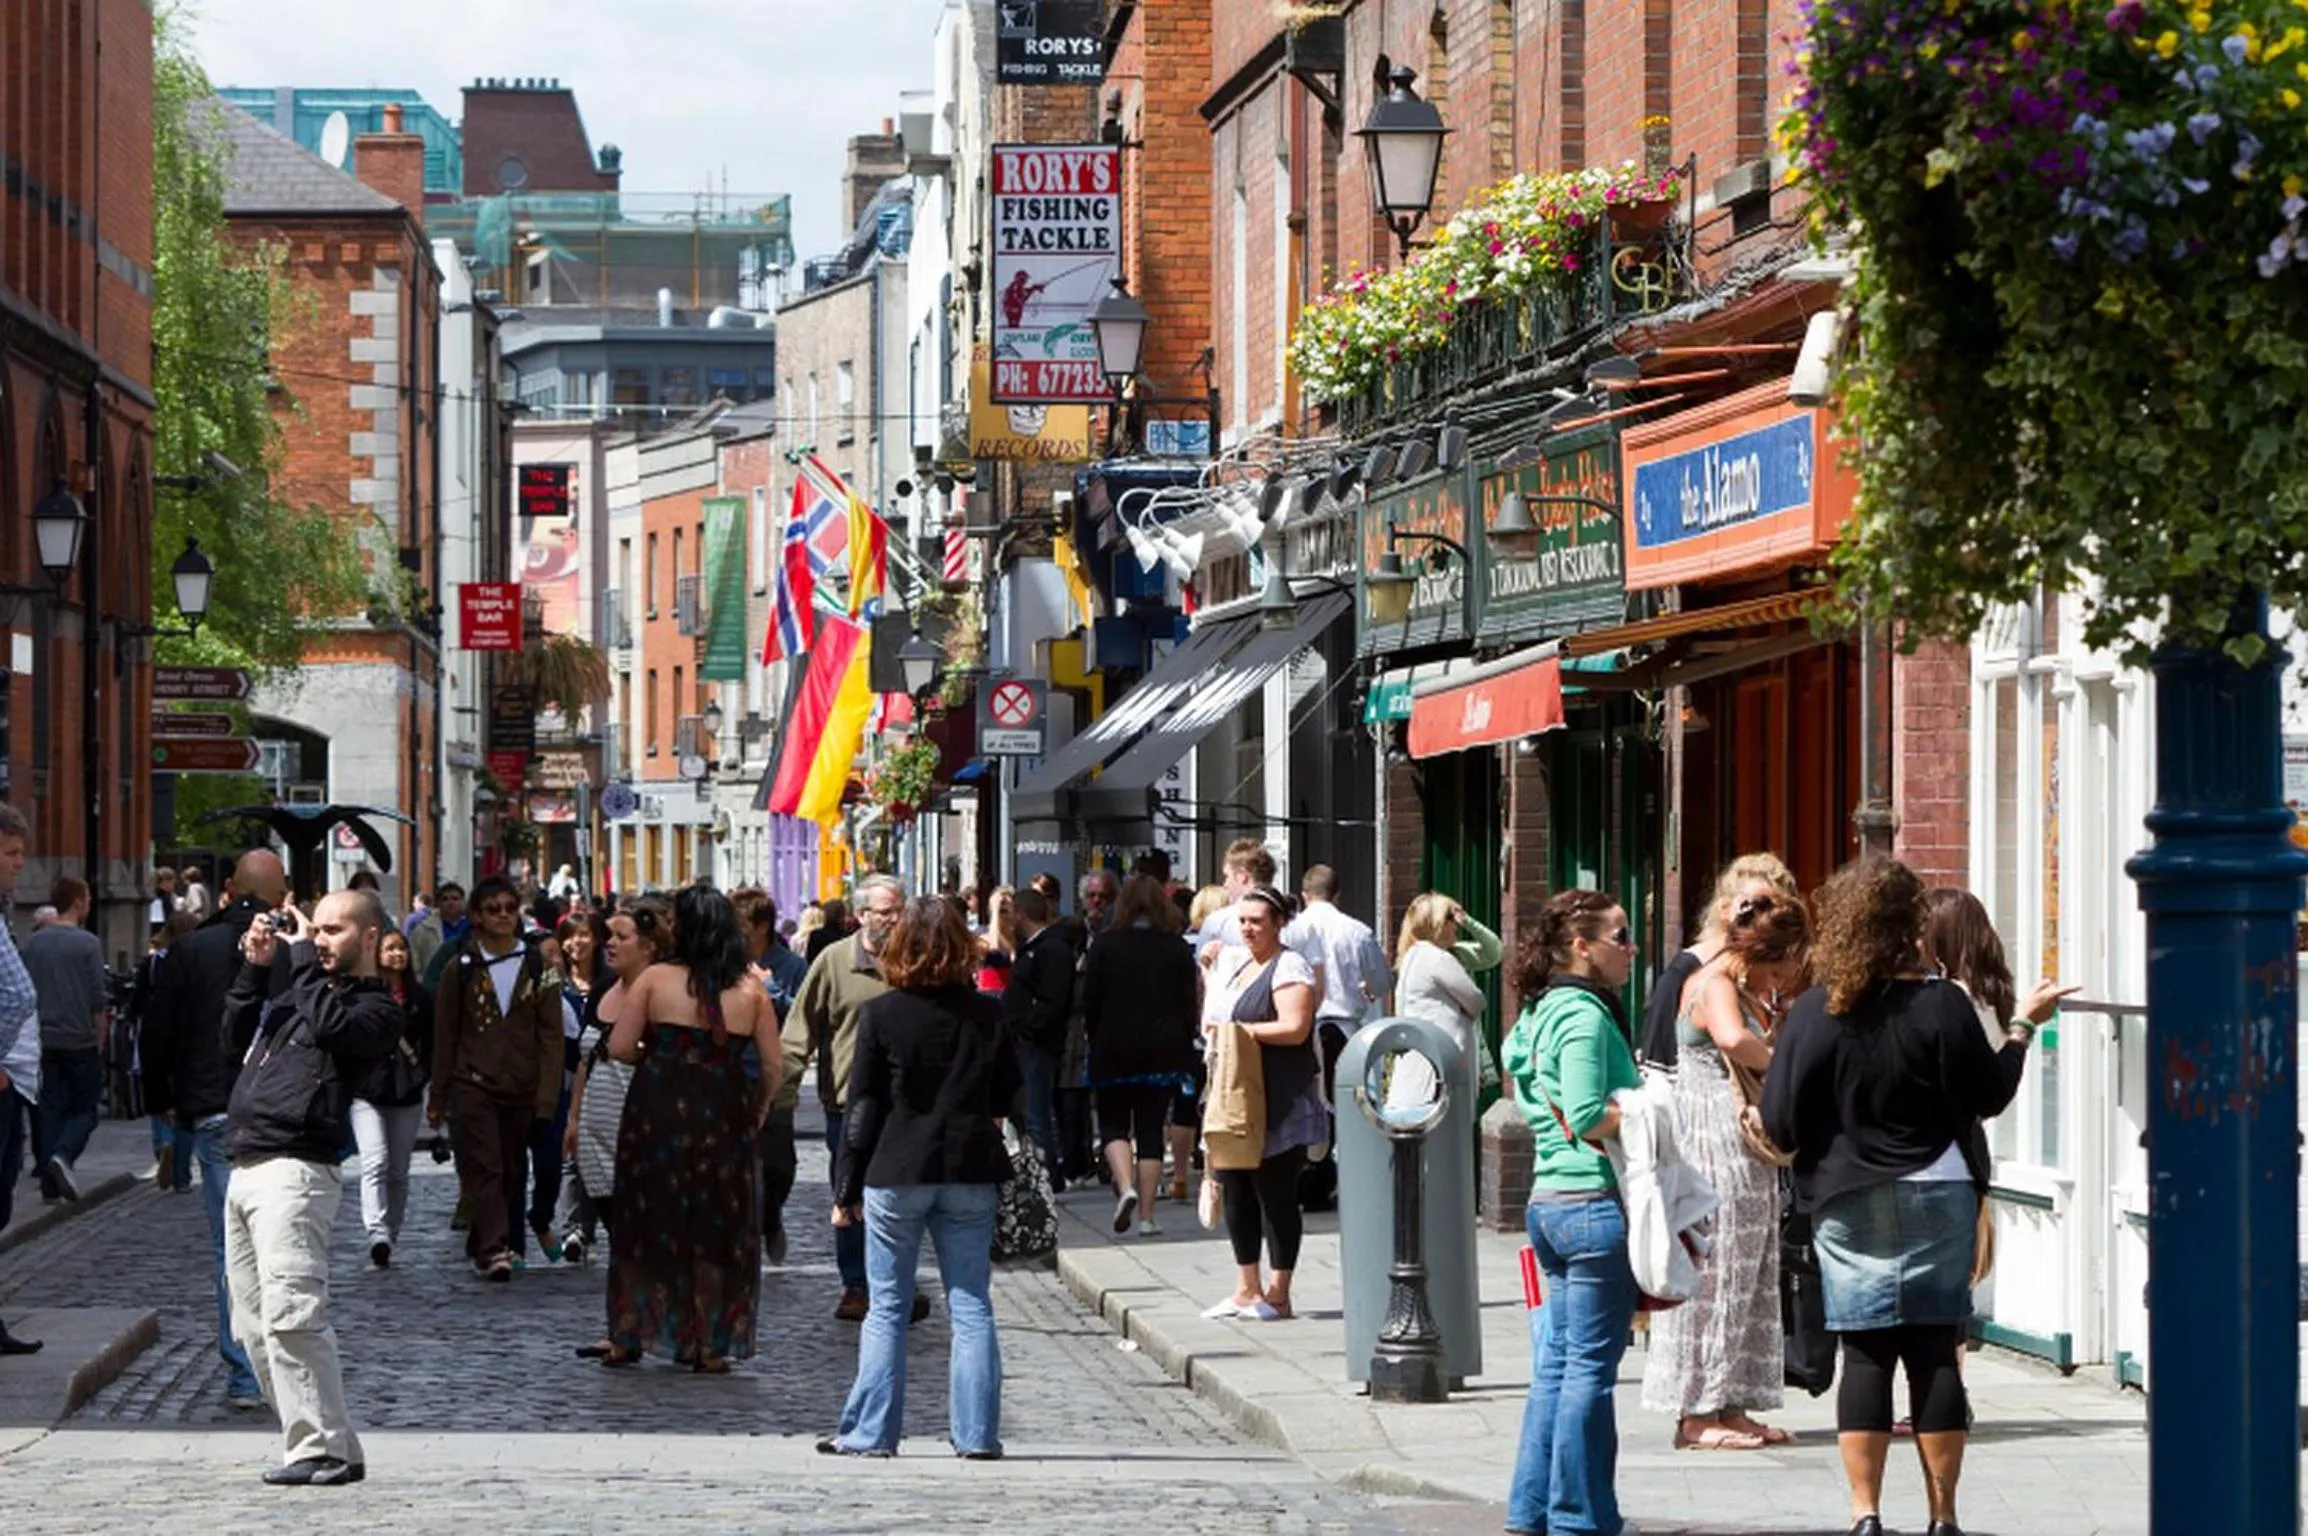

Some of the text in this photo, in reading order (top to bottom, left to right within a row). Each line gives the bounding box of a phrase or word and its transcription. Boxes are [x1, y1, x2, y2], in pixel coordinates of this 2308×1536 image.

[1057, 63, 1102, 77] TACKLE
[1002, 153, 1111, 192] RORY'S
[1002, 198, 1110, 221] FISHING
[1002, 227, 1110, 250] TACKLE
[996, 362, 1029, 394] PH:
[974, 438, 1085, 458] RECORDS
[1701, 444, 1761, 527] Alamo
[478, 586, 503, 597] THE
[466, 599, 514, 611] TEMPLE
[476, 612, 503, 623] BAR
